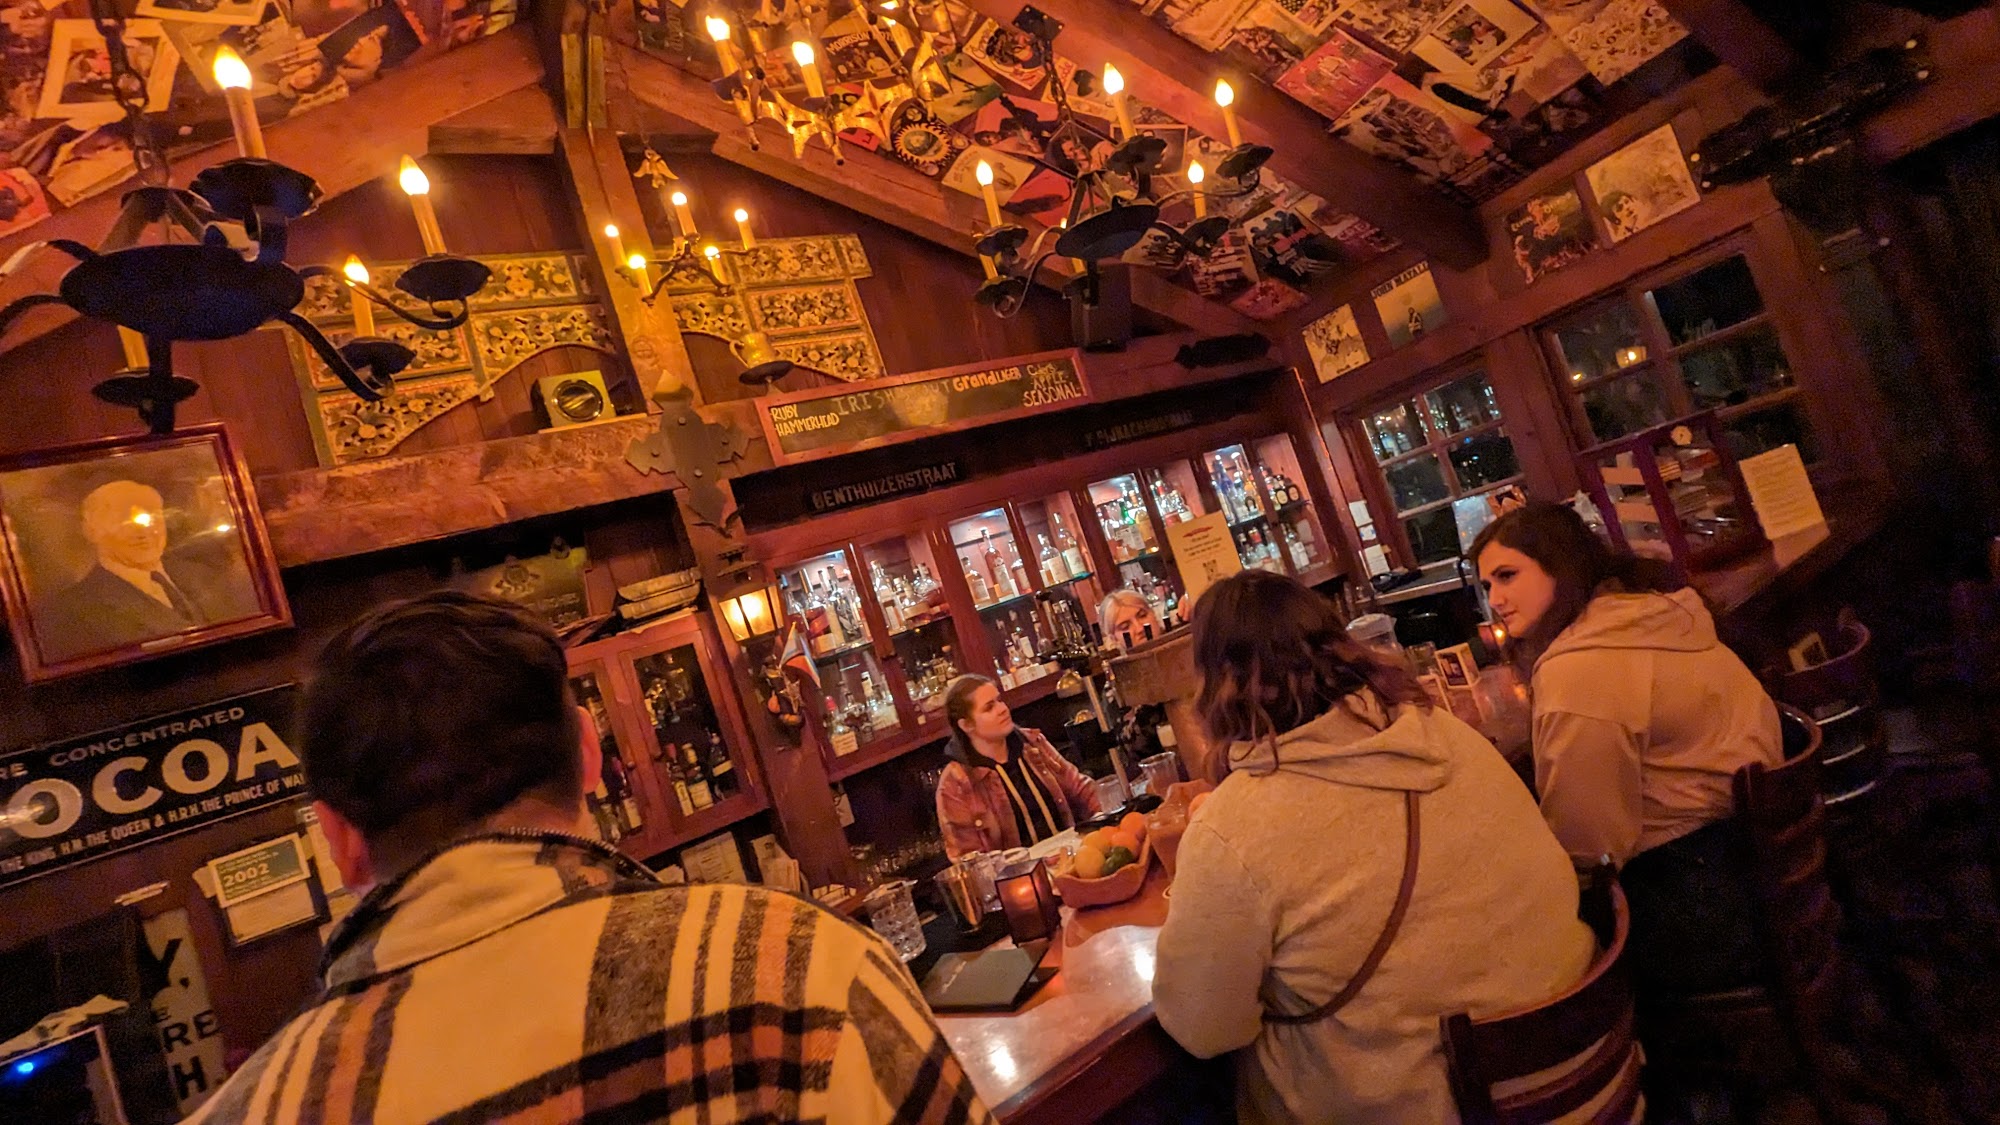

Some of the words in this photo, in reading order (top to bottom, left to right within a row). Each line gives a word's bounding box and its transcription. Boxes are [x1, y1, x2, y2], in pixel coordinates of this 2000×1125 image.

[953, 370, 998, 392] Grand
[770, 403, 799, 422] RUBY
[832, 388, 896, 416] IRISH
[775, 412, 840, 437] HAMMERHEAD
[49, 706, 245, 766] CONCENTRATED
[111, 818, 151, 840] QUEEN
[154, 813, 165, 829] &
[224, 785, 264, 806] PRINCE
[266, 780, 280, 795] OF
[223, 862, 270, 888] 2002
